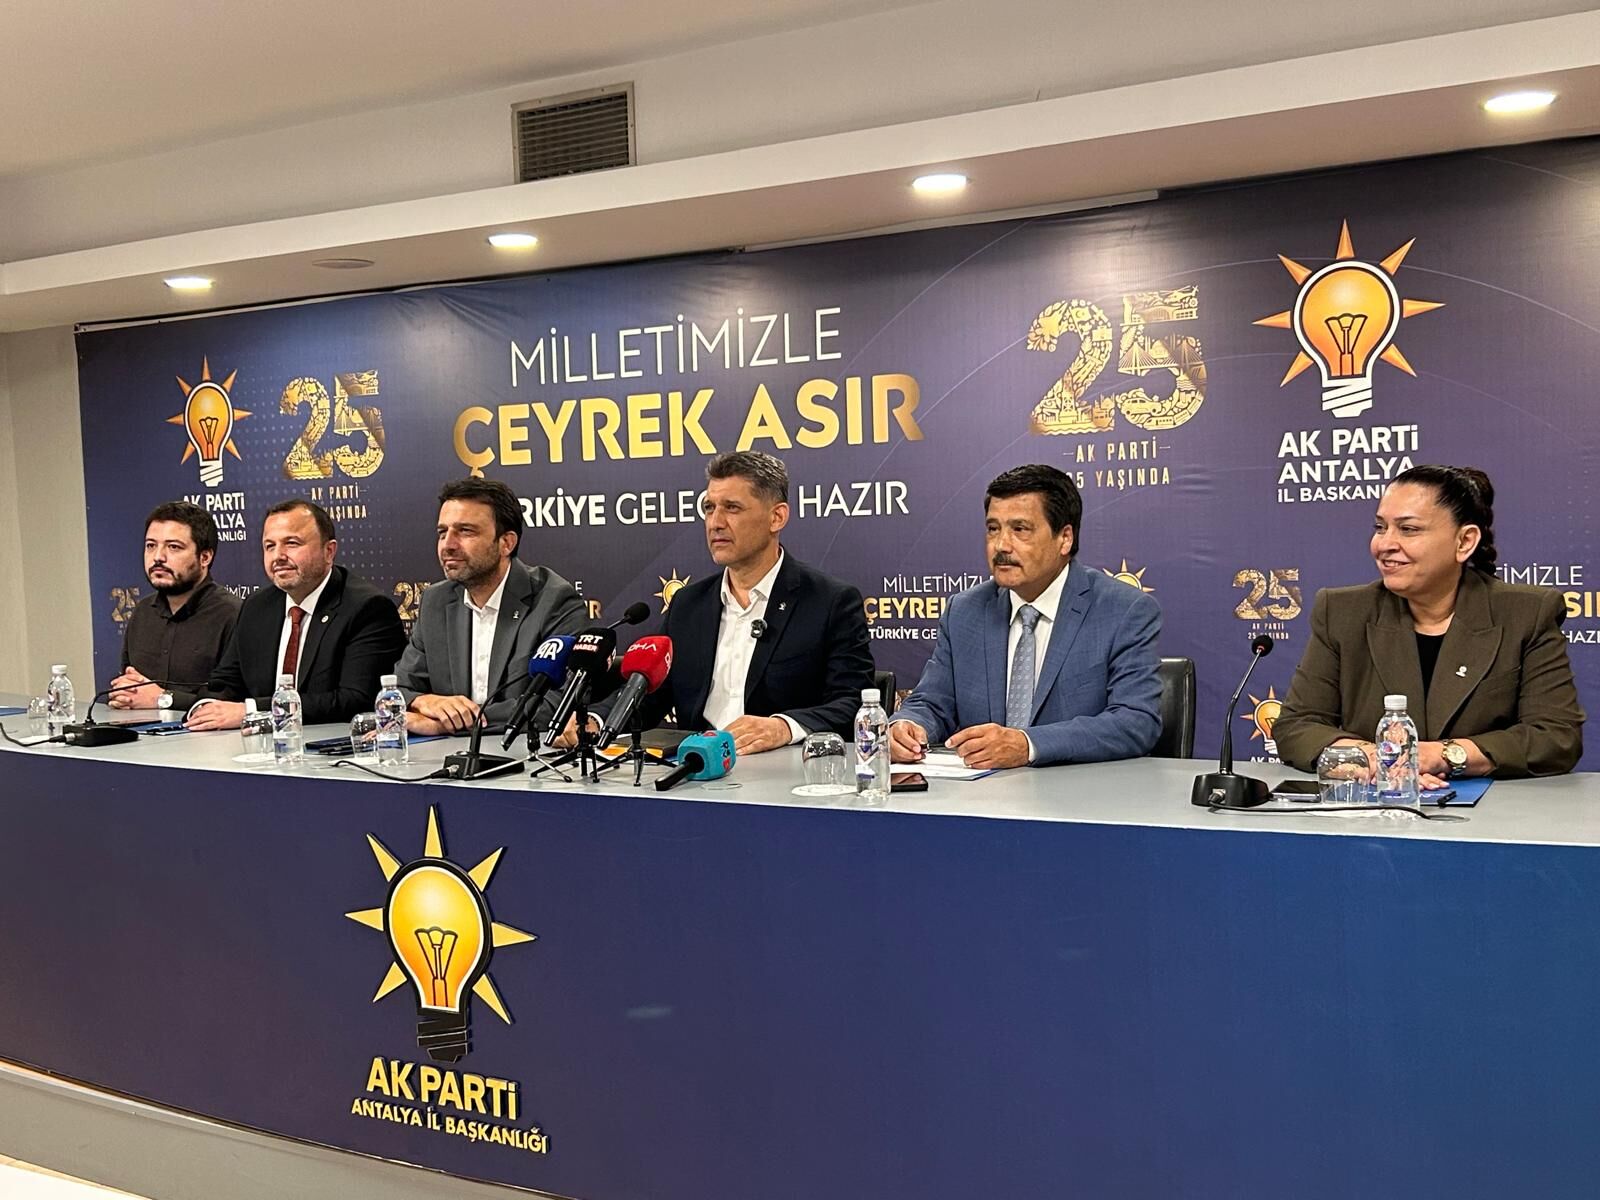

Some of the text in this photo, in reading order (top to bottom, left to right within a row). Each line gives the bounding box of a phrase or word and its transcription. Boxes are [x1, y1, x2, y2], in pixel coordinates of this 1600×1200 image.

[510, 306, 843, 388] MİLLETİMİZLE
[1026, 285, 1208, 436] 25
[279, 370, 387, 481] 25
[453, 373, 926, 478] ÇEYREK ASIR
[1277, 430, 1321, 458] AK
[1076, 436, 1157, 463] AK PARTİ
[329, 482, 359, 500] PARTİ
[1095, 467, 1170, 490] YAŞINDA
[517, 487, 607, 528] RKİYE
[798, 481, 910, 518] HAZIR
[1232, 568, 1303, 620] 25
[578, 634, 604, 644] TRT
[868, 626, 919, 640] TÜRKİYE
[366, 1057, 415, 1100] AK
[351, 1097, 549, 1155] ANTALYA İL BAŞKANLIĞI
